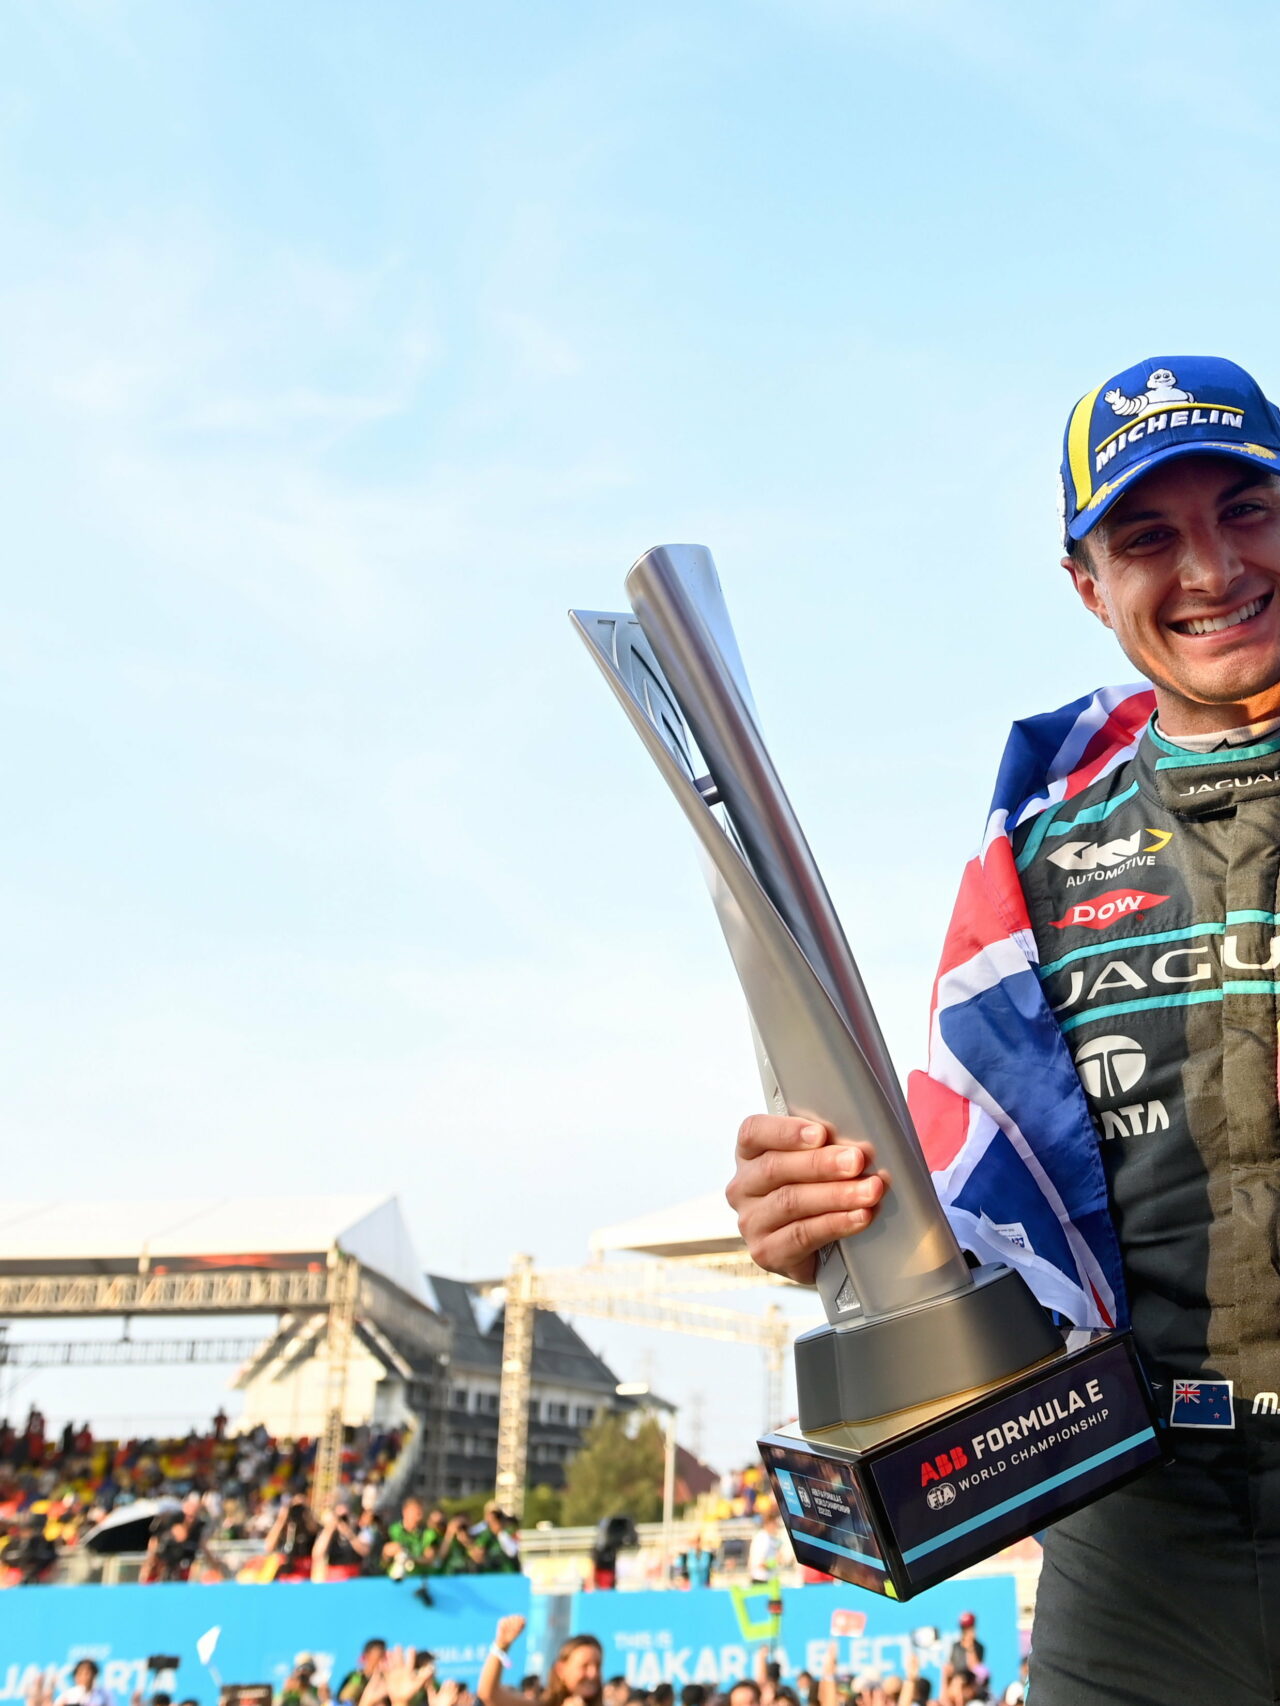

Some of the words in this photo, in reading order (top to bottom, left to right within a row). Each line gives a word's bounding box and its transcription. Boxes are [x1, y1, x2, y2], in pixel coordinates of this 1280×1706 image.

[1095, 409, 1244, 473] MICHELIN
[1066, 855, 1156, 888] AUTOMOTIVE
[1071, 894, 1146, 924] DOW
[1092, 1099, 1170, 1140] ATA
[921, 1446, 968, 1487] ABB
[971, 1389, 1086, 1459] FORMULA
[1085, 1378, 1104, 1403] E
[927, 1483, 956, 1510] FIA
[958, 1460, 1007, 1491] WORLD
[1010, 1408, 1110, 1465] CHAMPIONSHIP
[0, 1658, 179, 1698] JAKRTA
